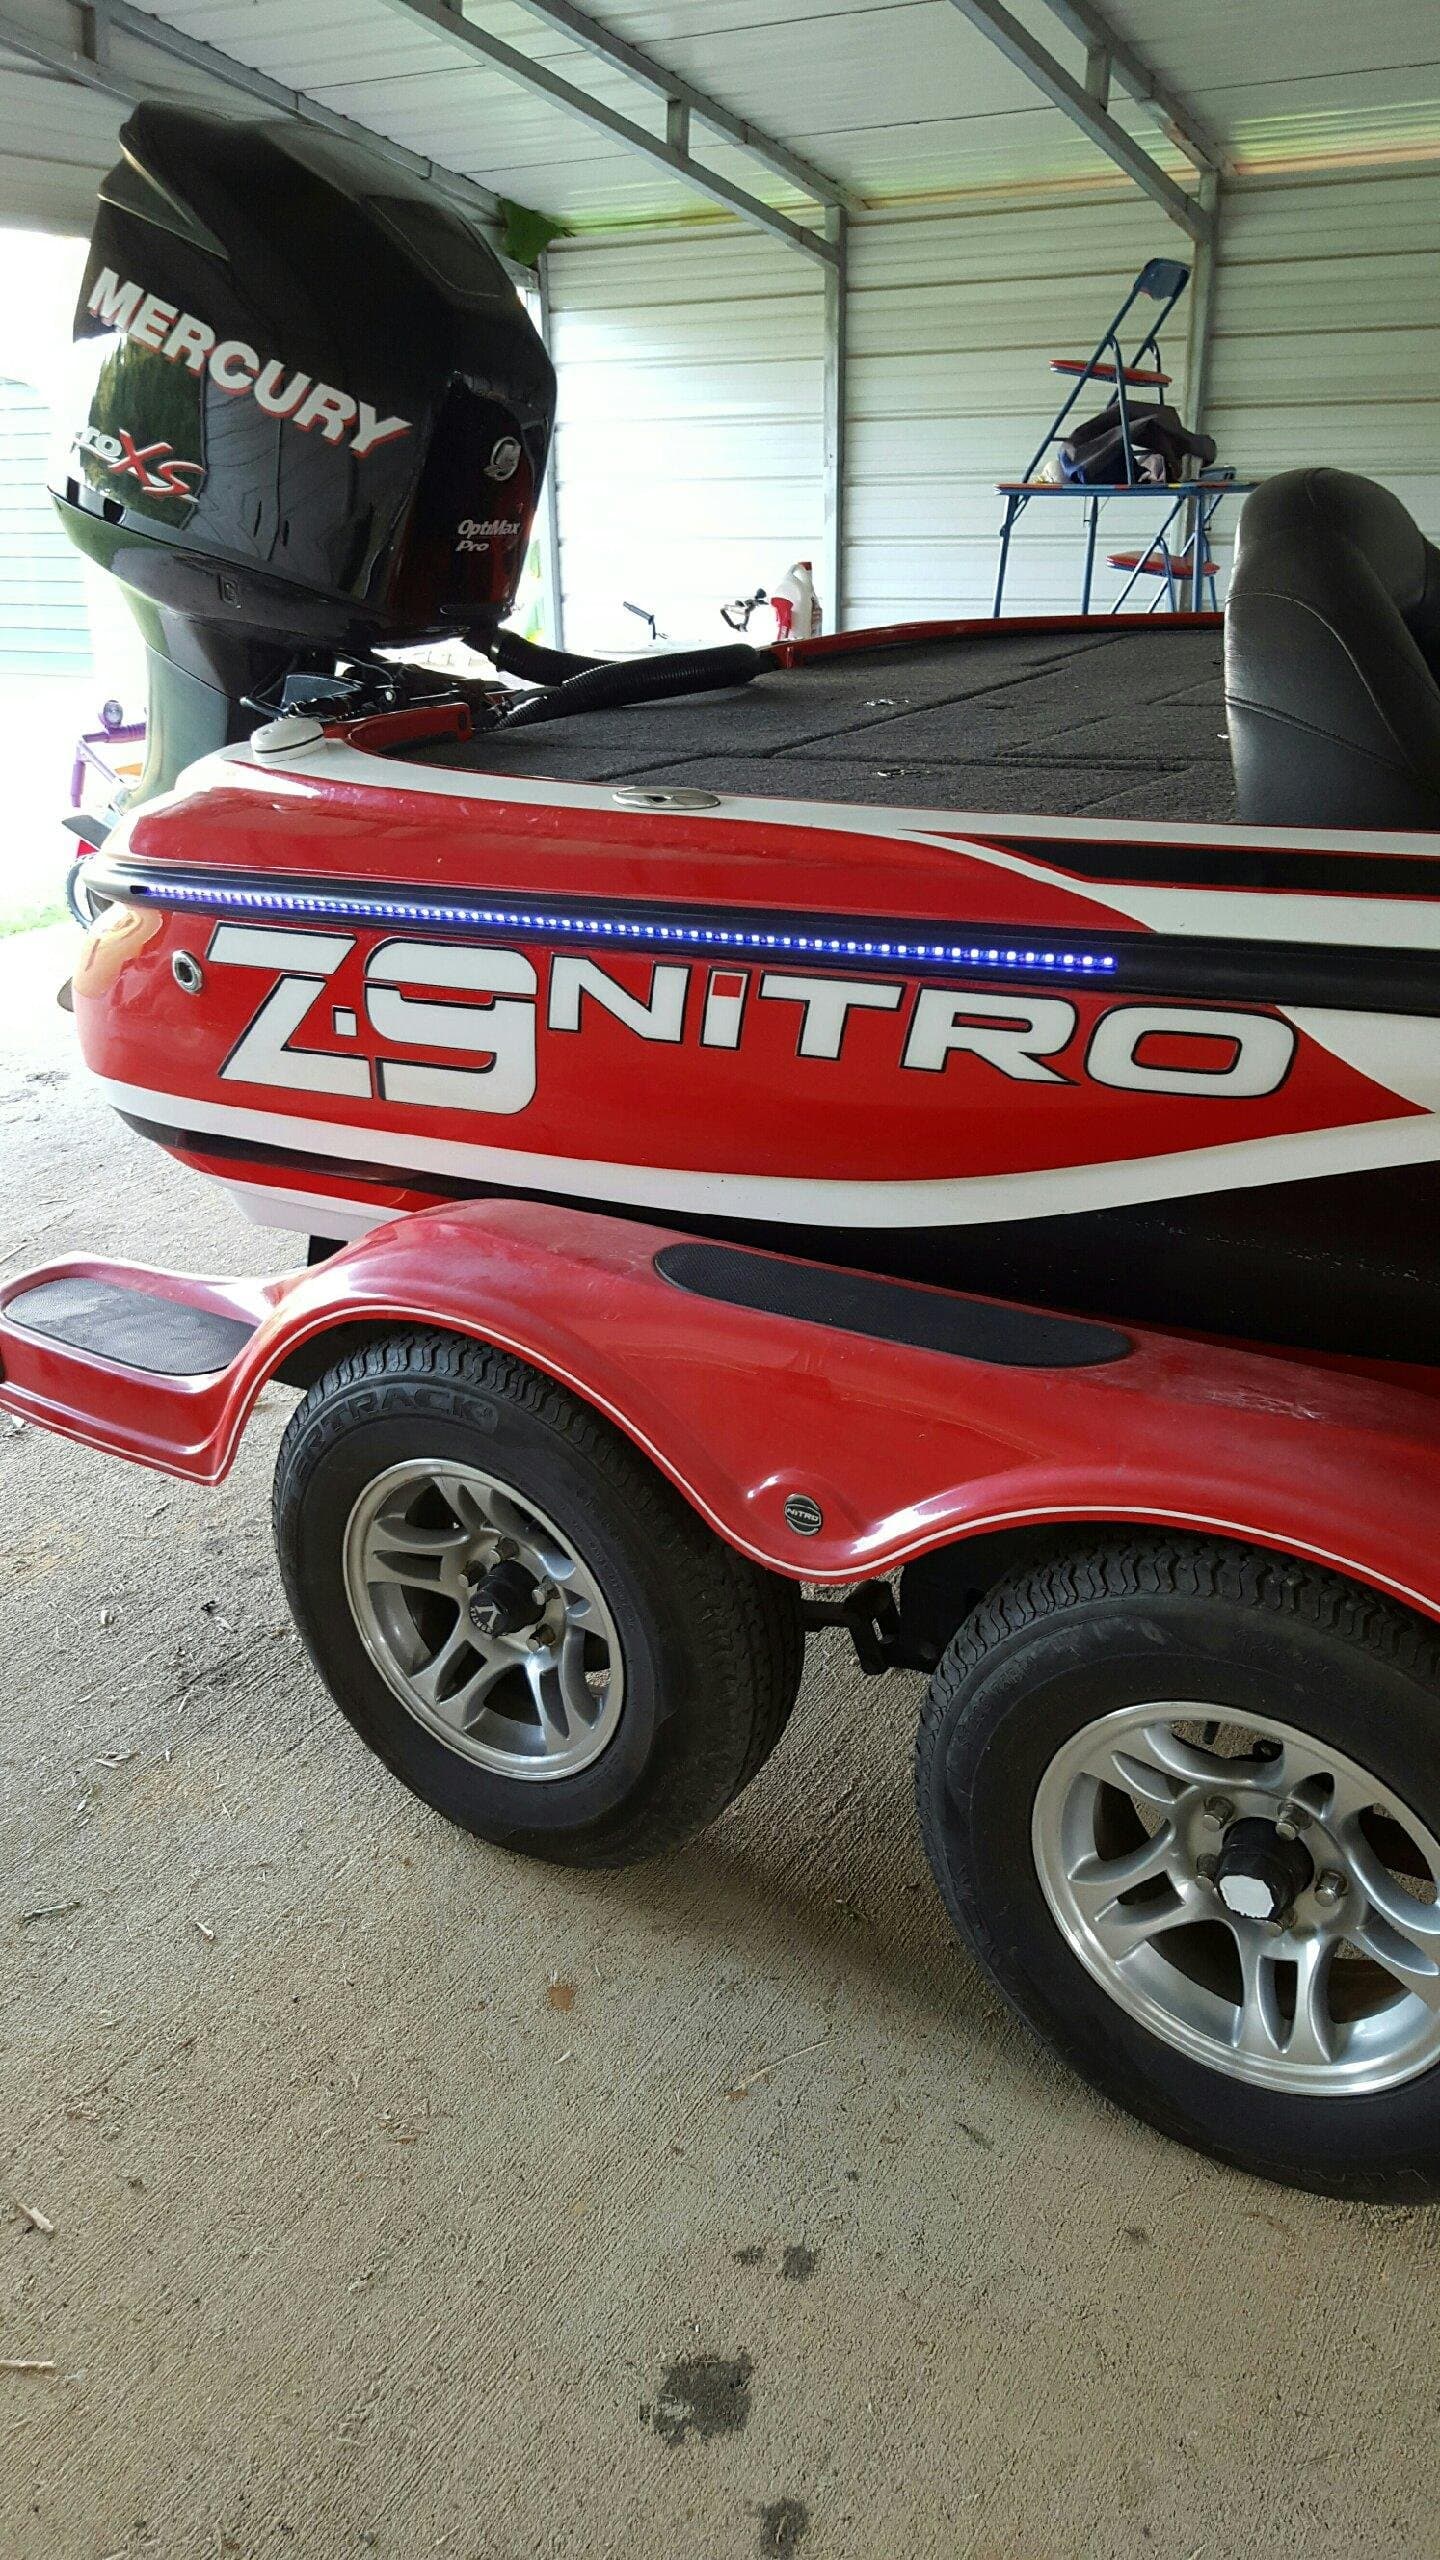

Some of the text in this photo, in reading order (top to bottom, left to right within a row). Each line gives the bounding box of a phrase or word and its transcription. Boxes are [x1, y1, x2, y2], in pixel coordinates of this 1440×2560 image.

[87, 266, 413, 457] MERCURY
[457, 519, 521, 540] OptiMax
[455, 540, 490, 552] Pro
[547, 953, 1296, 1097] NITRO
[786, 1507, 819, 1522] NITRO
